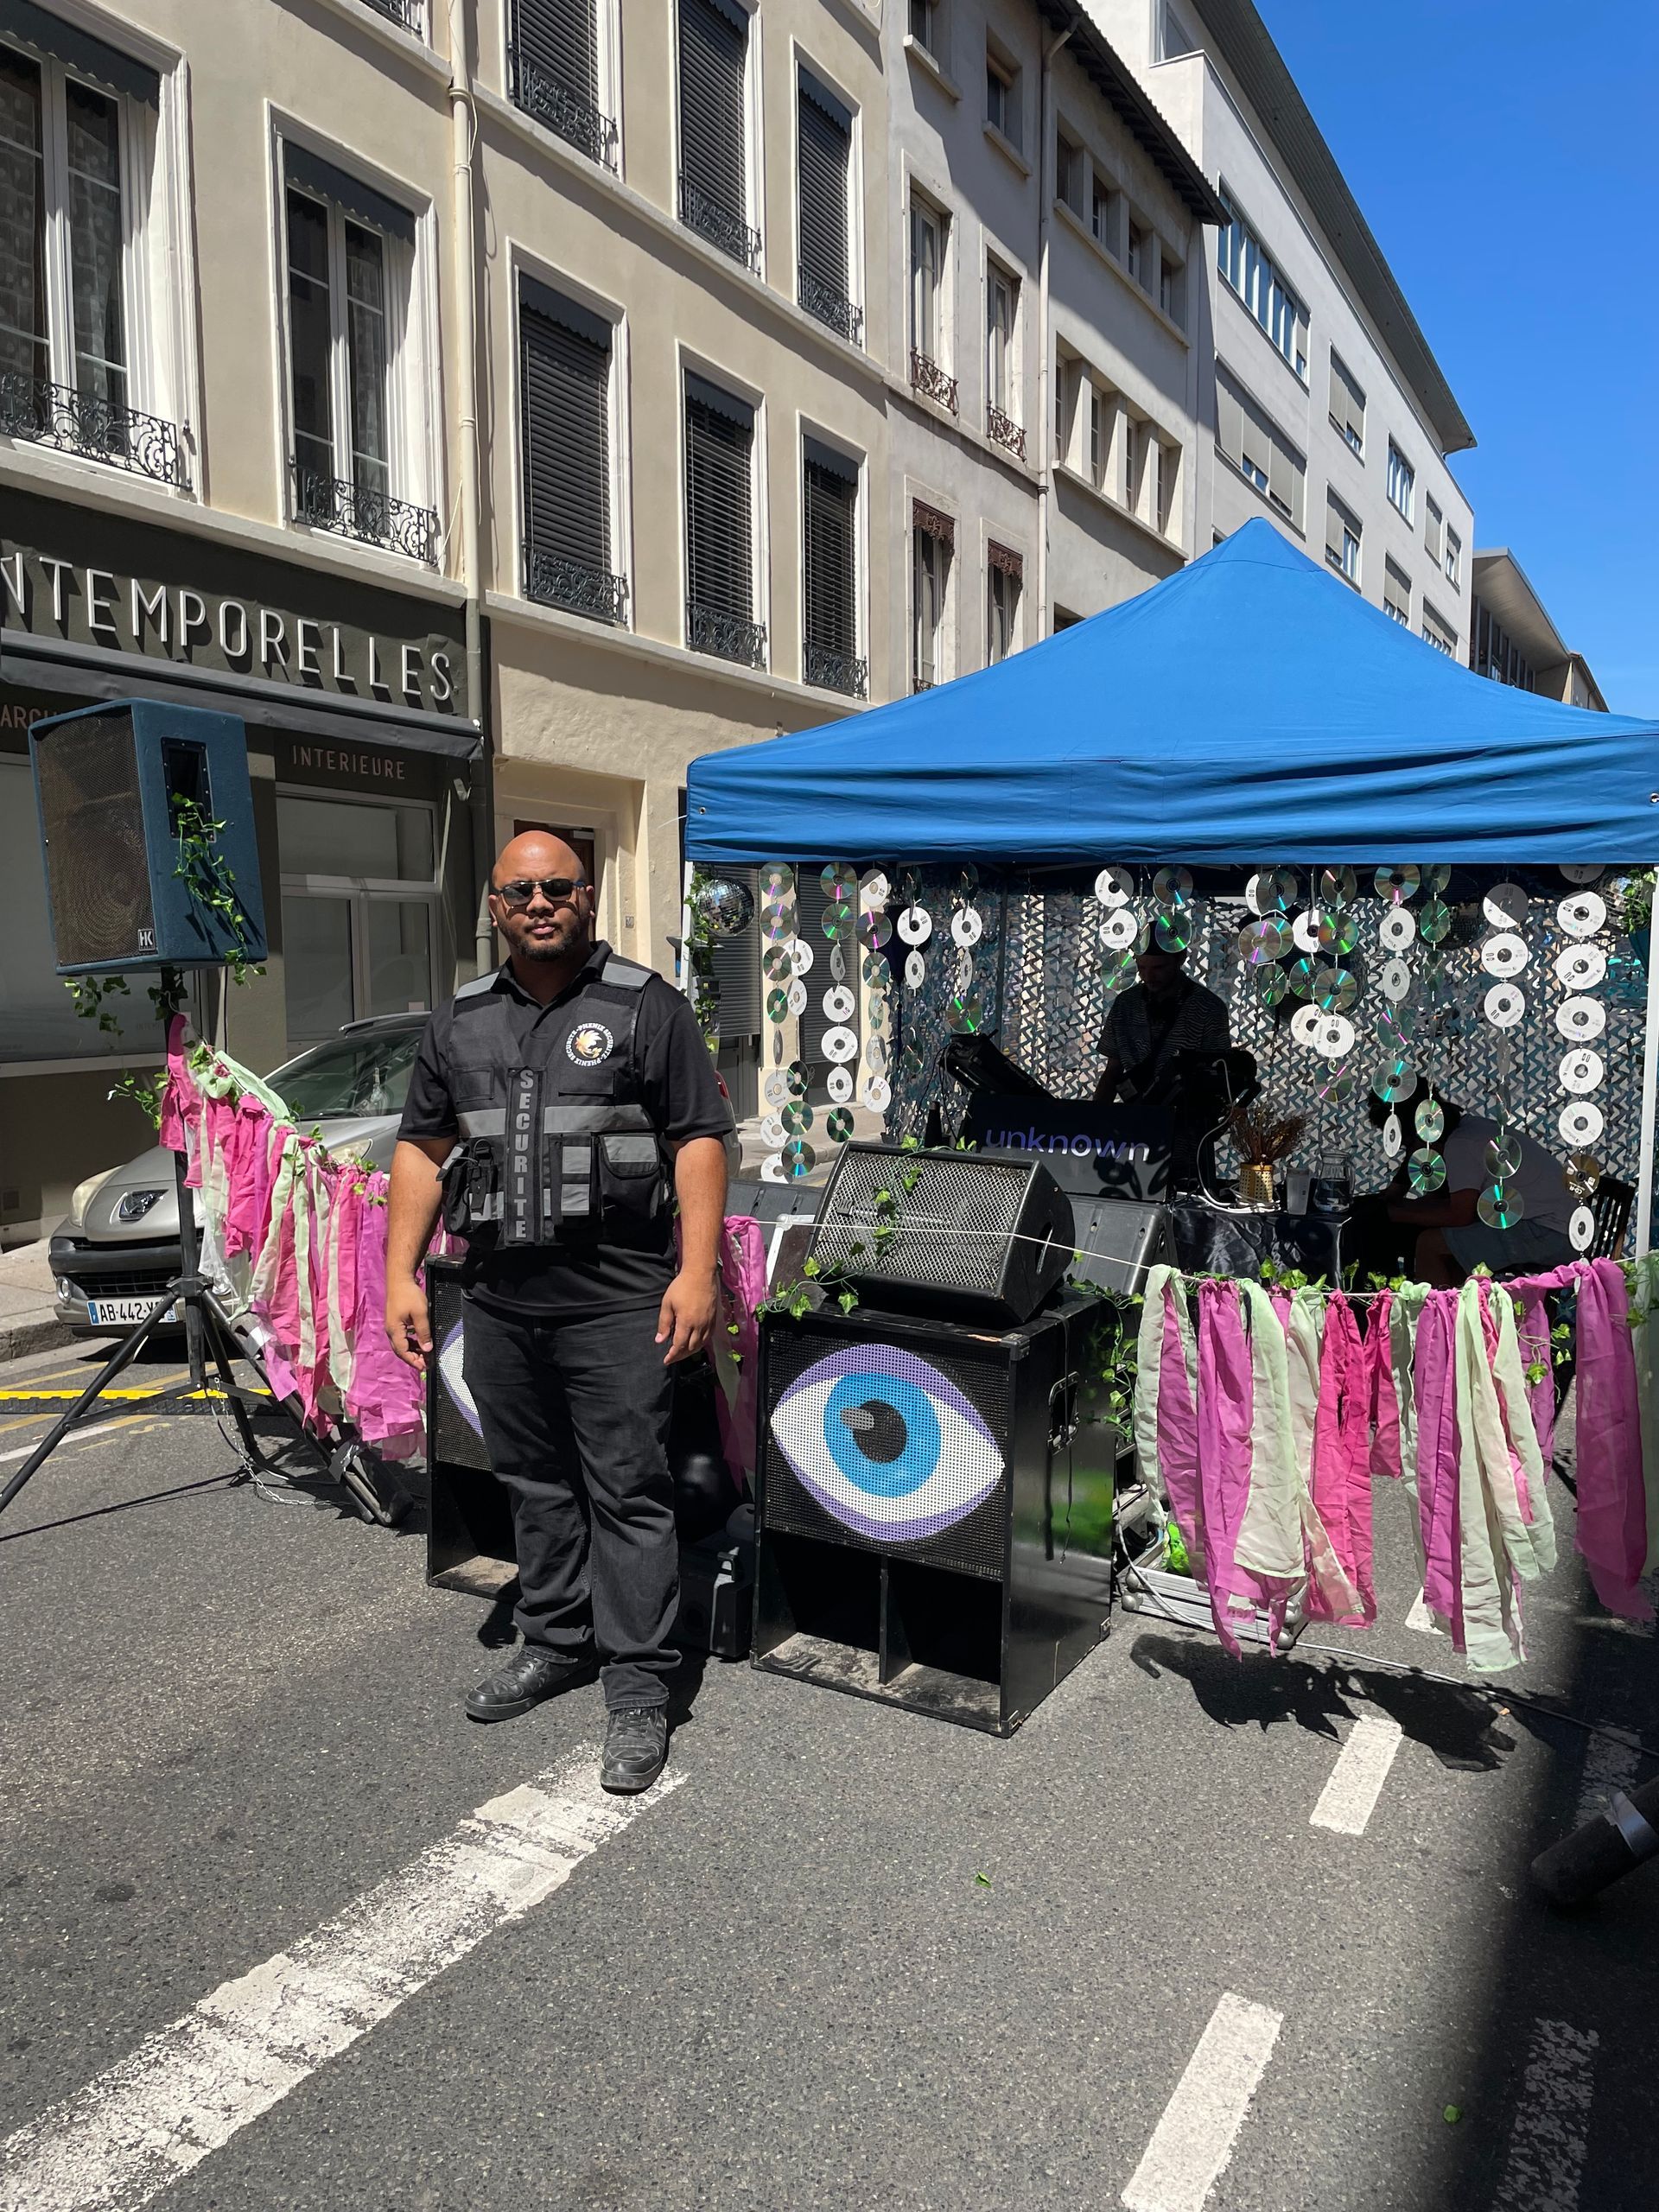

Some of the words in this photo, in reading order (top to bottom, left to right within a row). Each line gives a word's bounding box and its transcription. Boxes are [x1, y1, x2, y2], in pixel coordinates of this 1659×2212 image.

[0, 704, 57, 729] ARC
[293, 745, 405, 779] INTERIEURE
[140, 931, 153, 946] HK
[602, 1028, 613, 1059] SECURITE
[514, 1070, 534, 1238] SECURITE
[986, 1127, 1149, 1161] unknown
[99, 1302, 164, 1321] AB-442-Y
